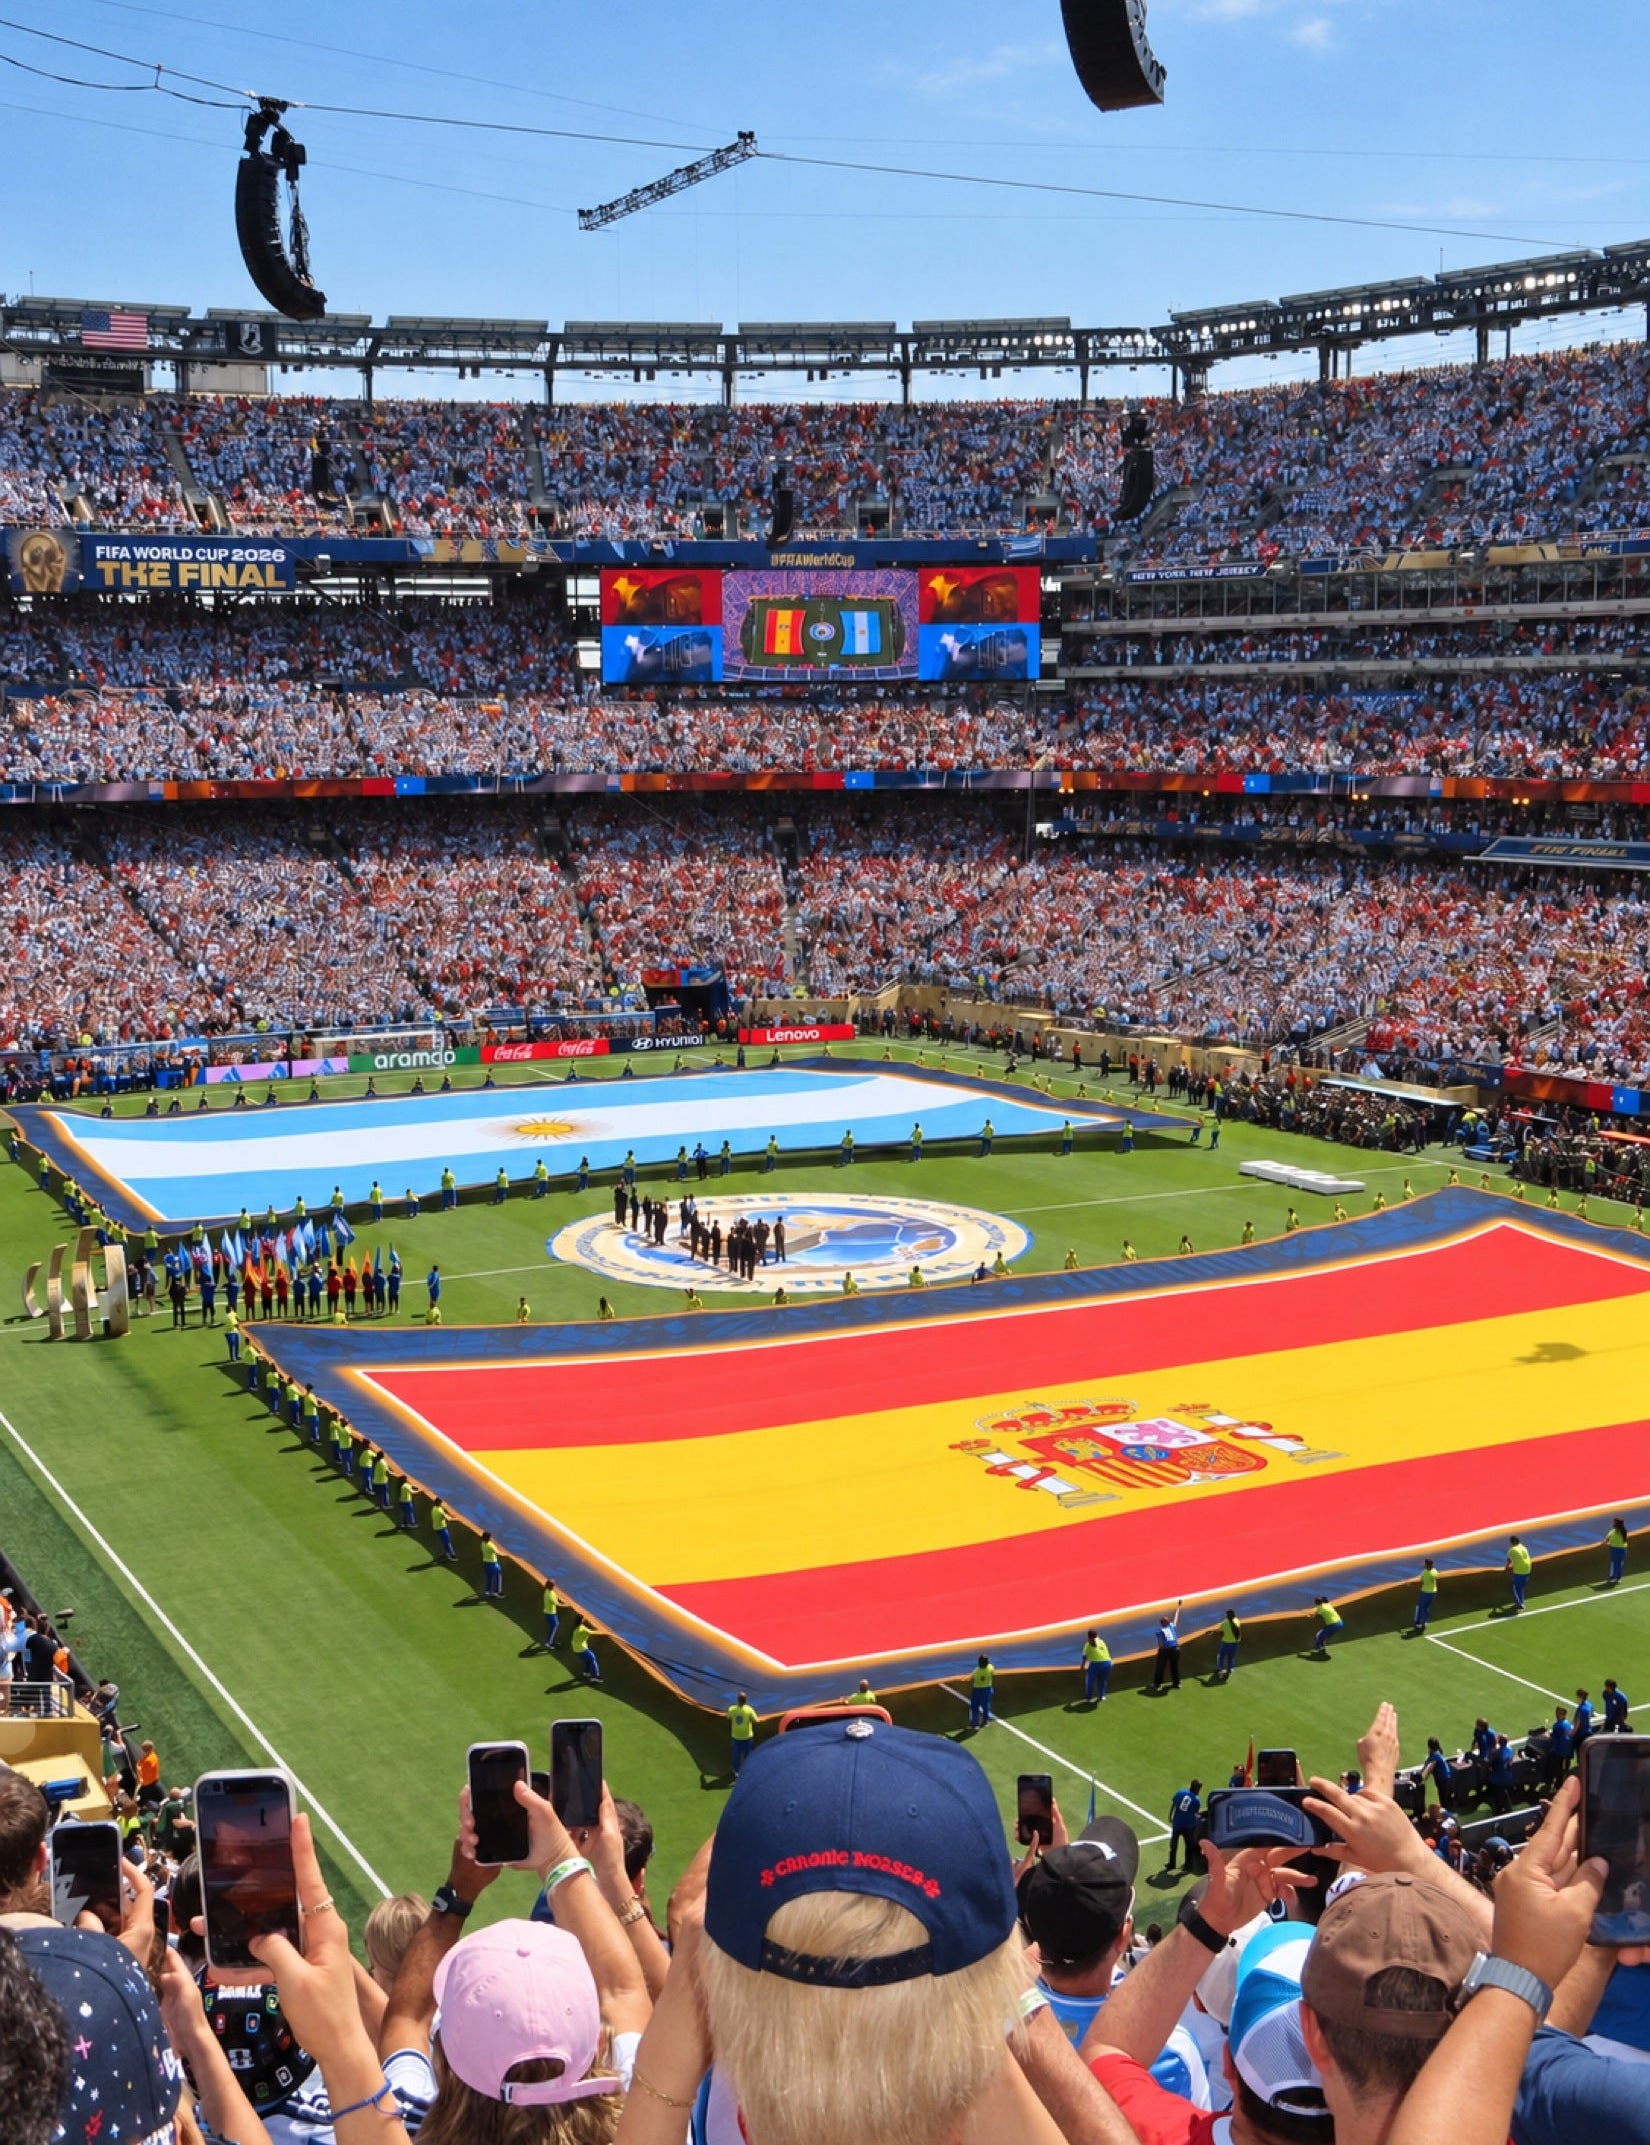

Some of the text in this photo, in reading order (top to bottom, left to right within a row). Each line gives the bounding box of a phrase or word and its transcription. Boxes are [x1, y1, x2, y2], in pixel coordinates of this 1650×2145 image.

[95, 546, 286, 561] FIFA WORLD CUP 2026
[96, 561, 287, 587] THE FINAL
[767, 1029, 820, 1042] Lenovo
